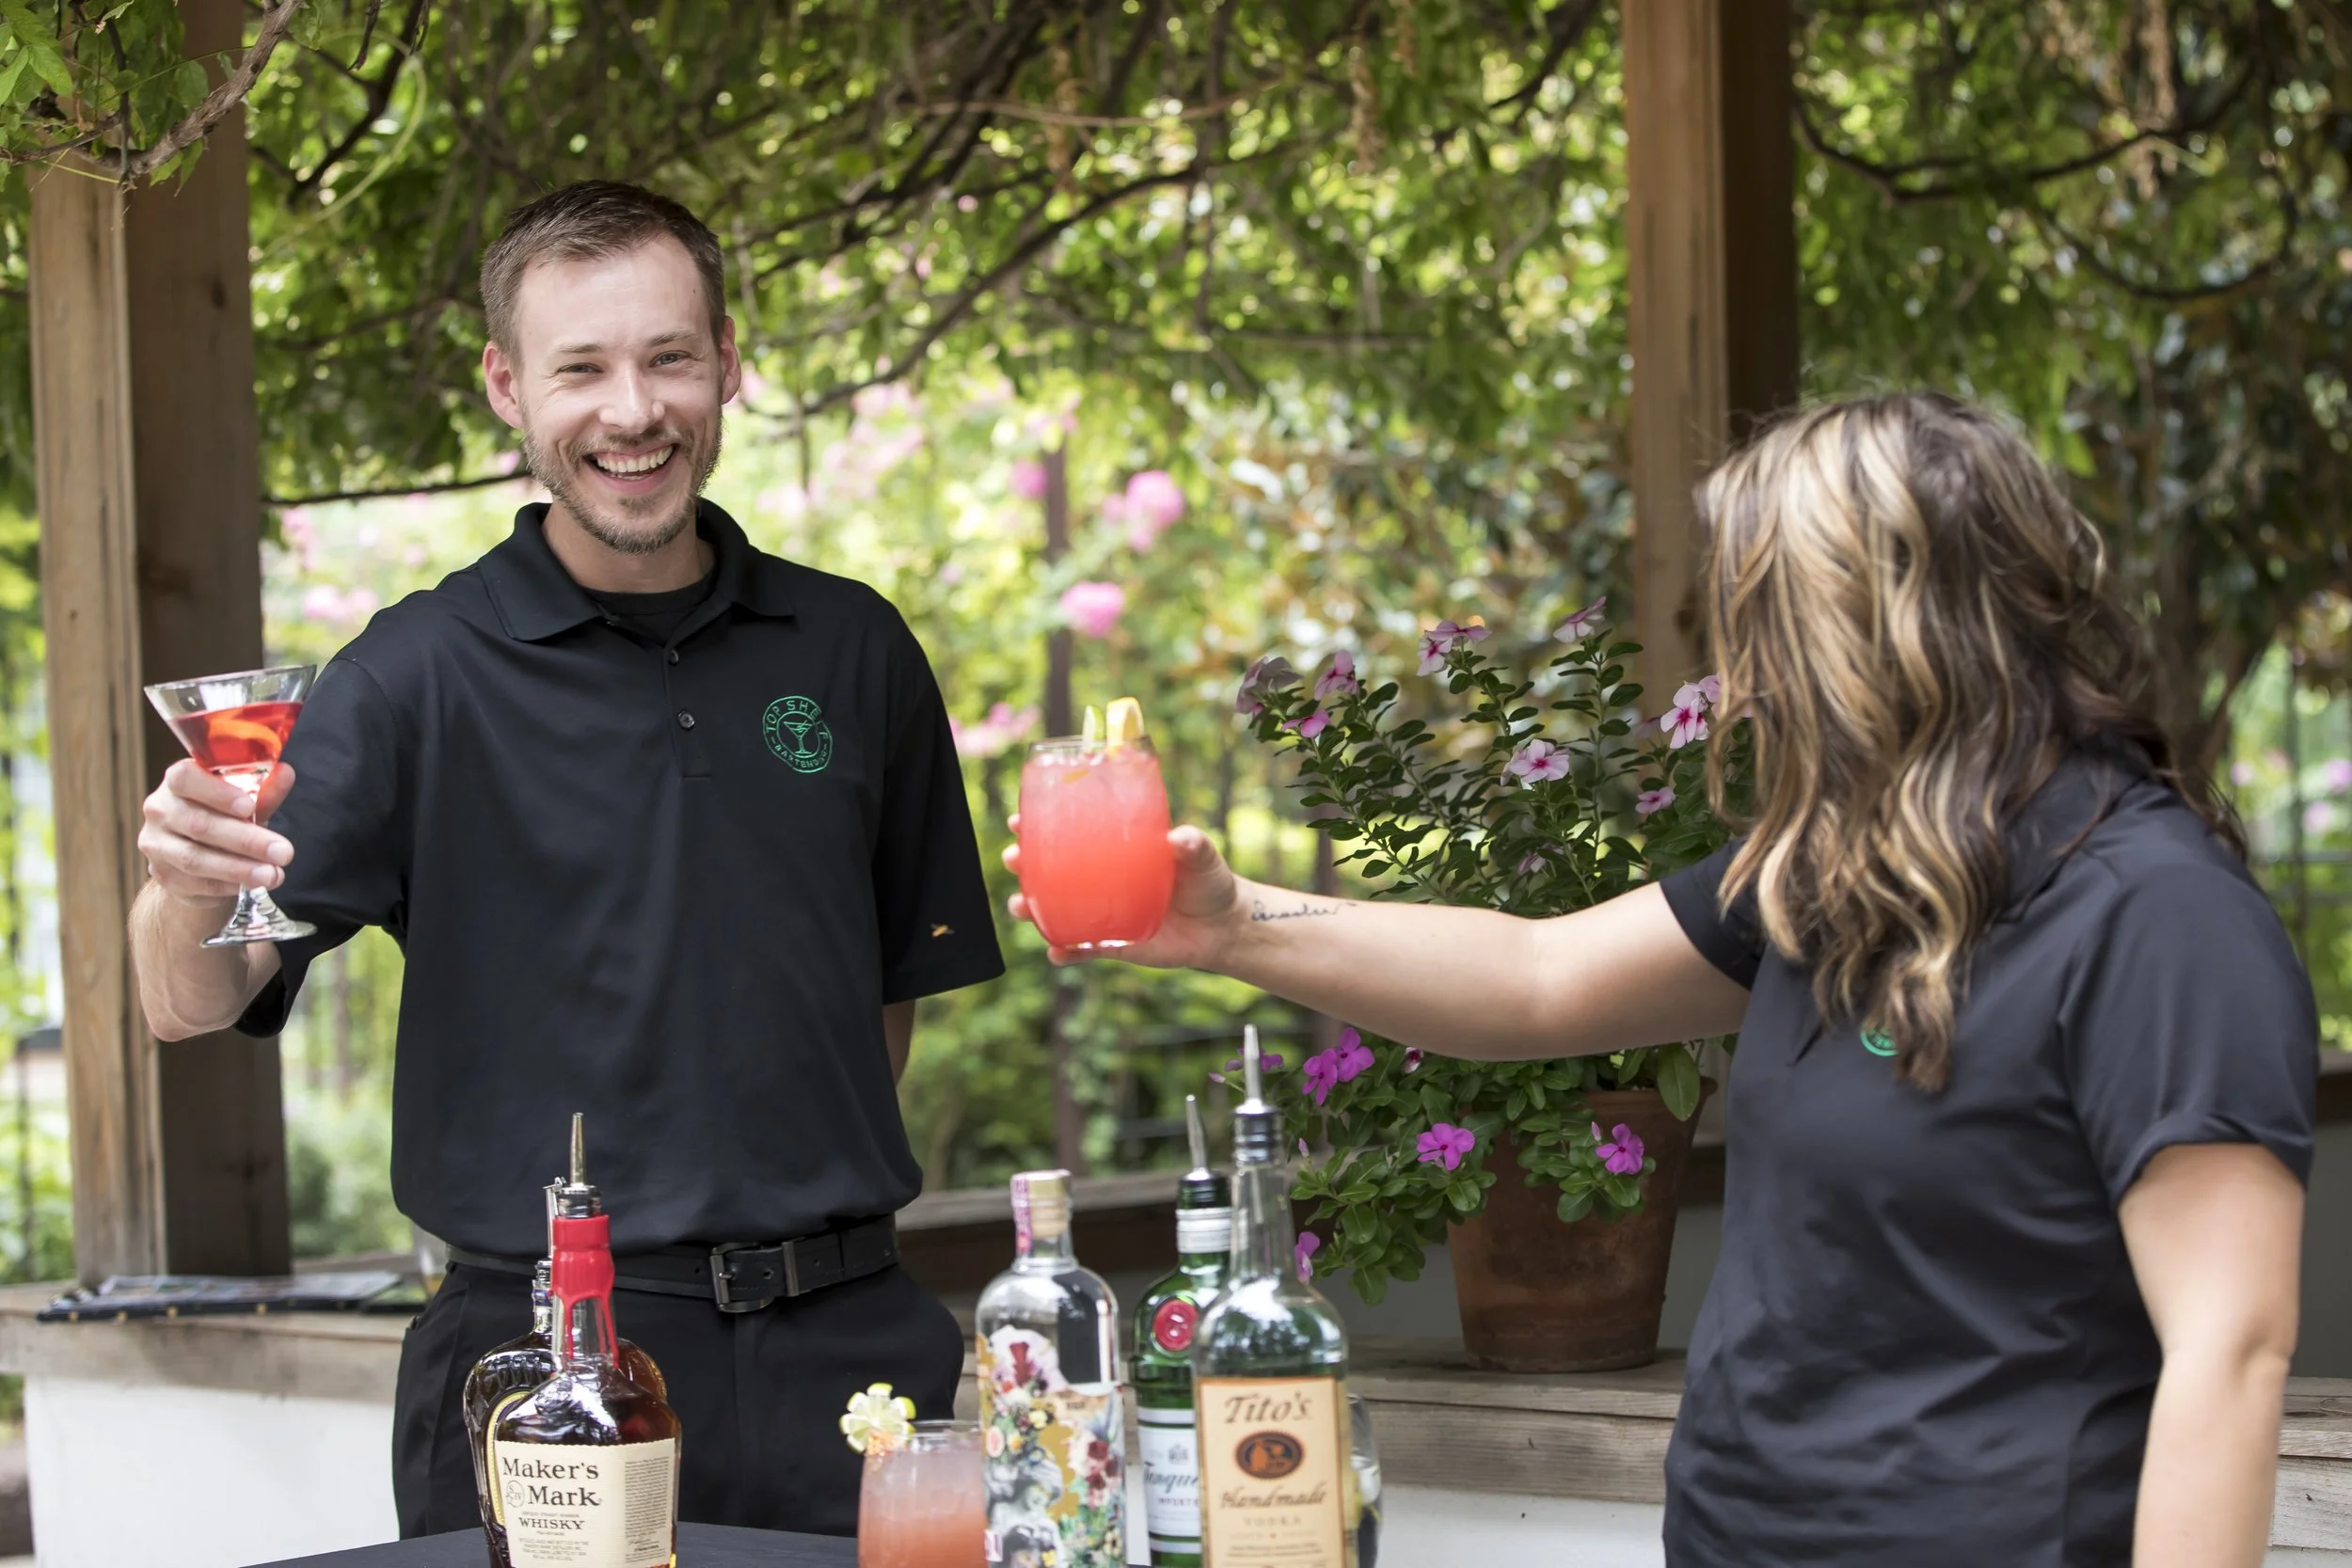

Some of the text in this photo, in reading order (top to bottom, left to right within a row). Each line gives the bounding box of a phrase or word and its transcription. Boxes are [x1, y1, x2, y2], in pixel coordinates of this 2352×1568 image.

[766, 705, 781, 733] TOP
[1224, 1390, 1313, 1423] Tito's
[502, 1457, 598, 1480] Maker's
[527, 1485, 600, 1506] Mark
[518, 1516, 585, 1530] WHISKY
